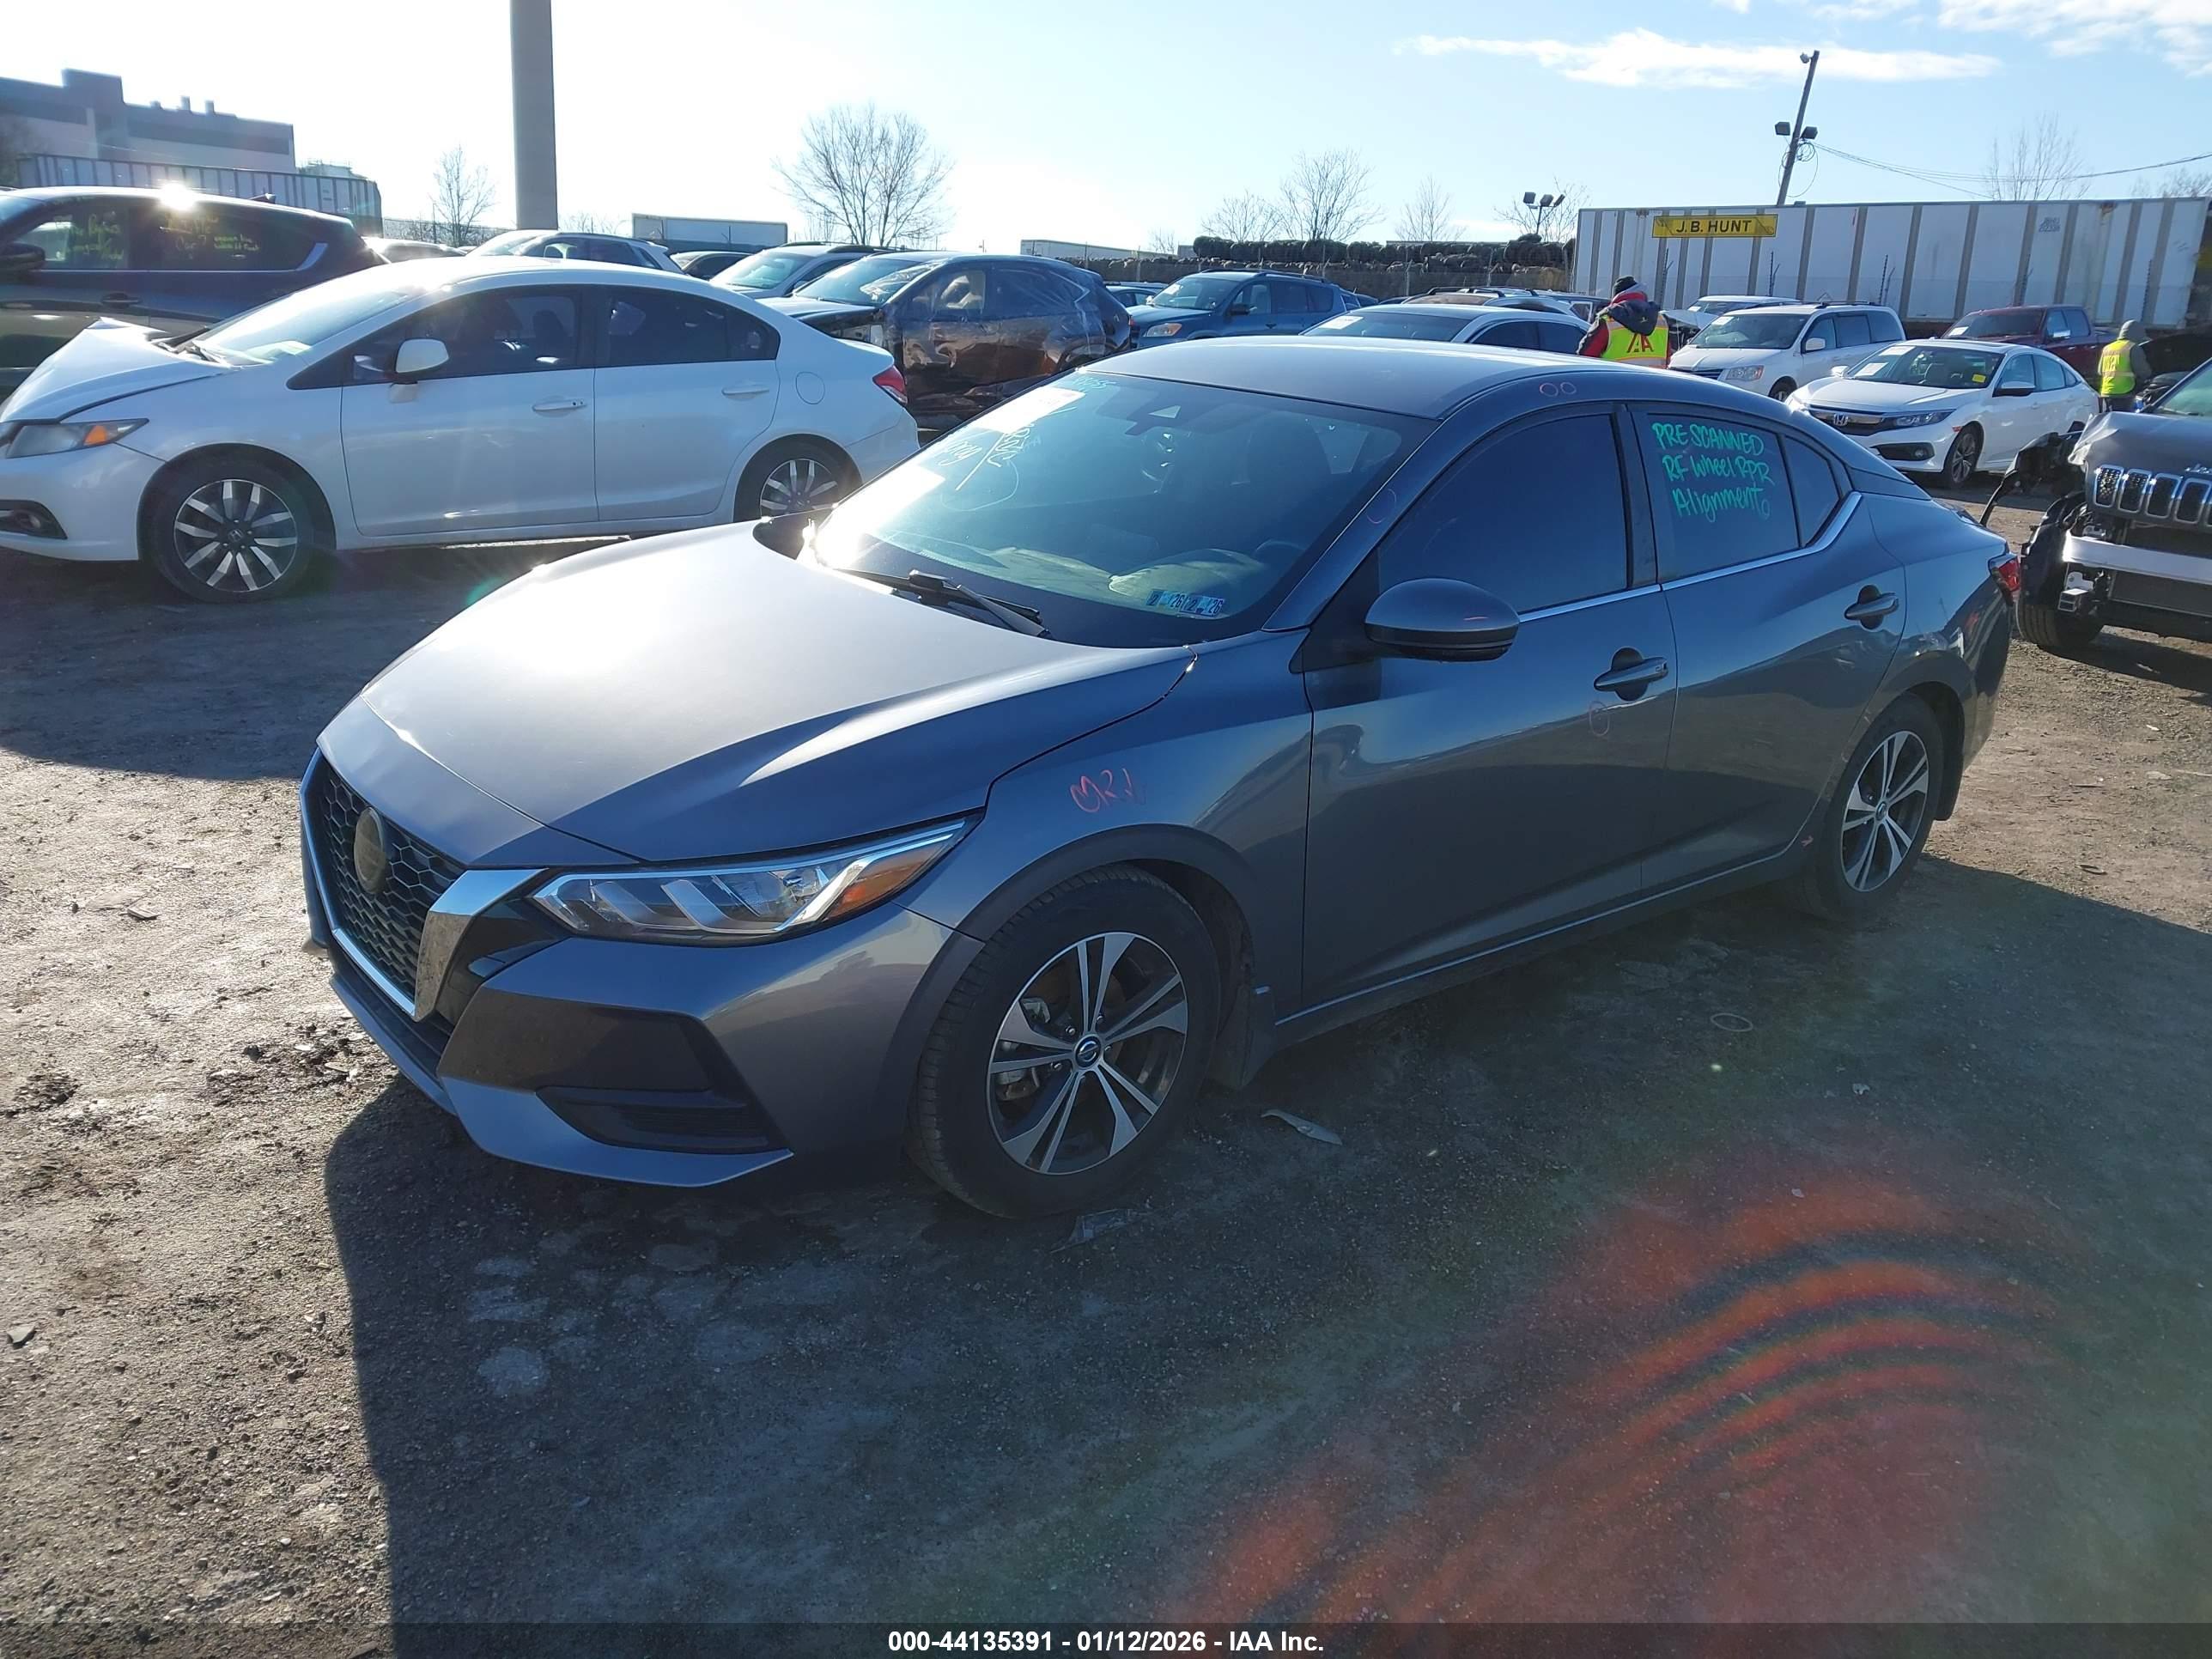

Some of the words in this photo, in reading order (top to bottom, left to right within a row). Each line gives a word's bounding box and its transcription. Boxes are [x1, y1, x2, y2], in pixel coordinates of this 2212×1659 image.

[1707, 219, 1753, 233] HUNT
[1651, 422, 1689, 451] PRE
[1690, 424, 1764, 456] SCANNED
[1672, 481, 1764, 523] Alignment
